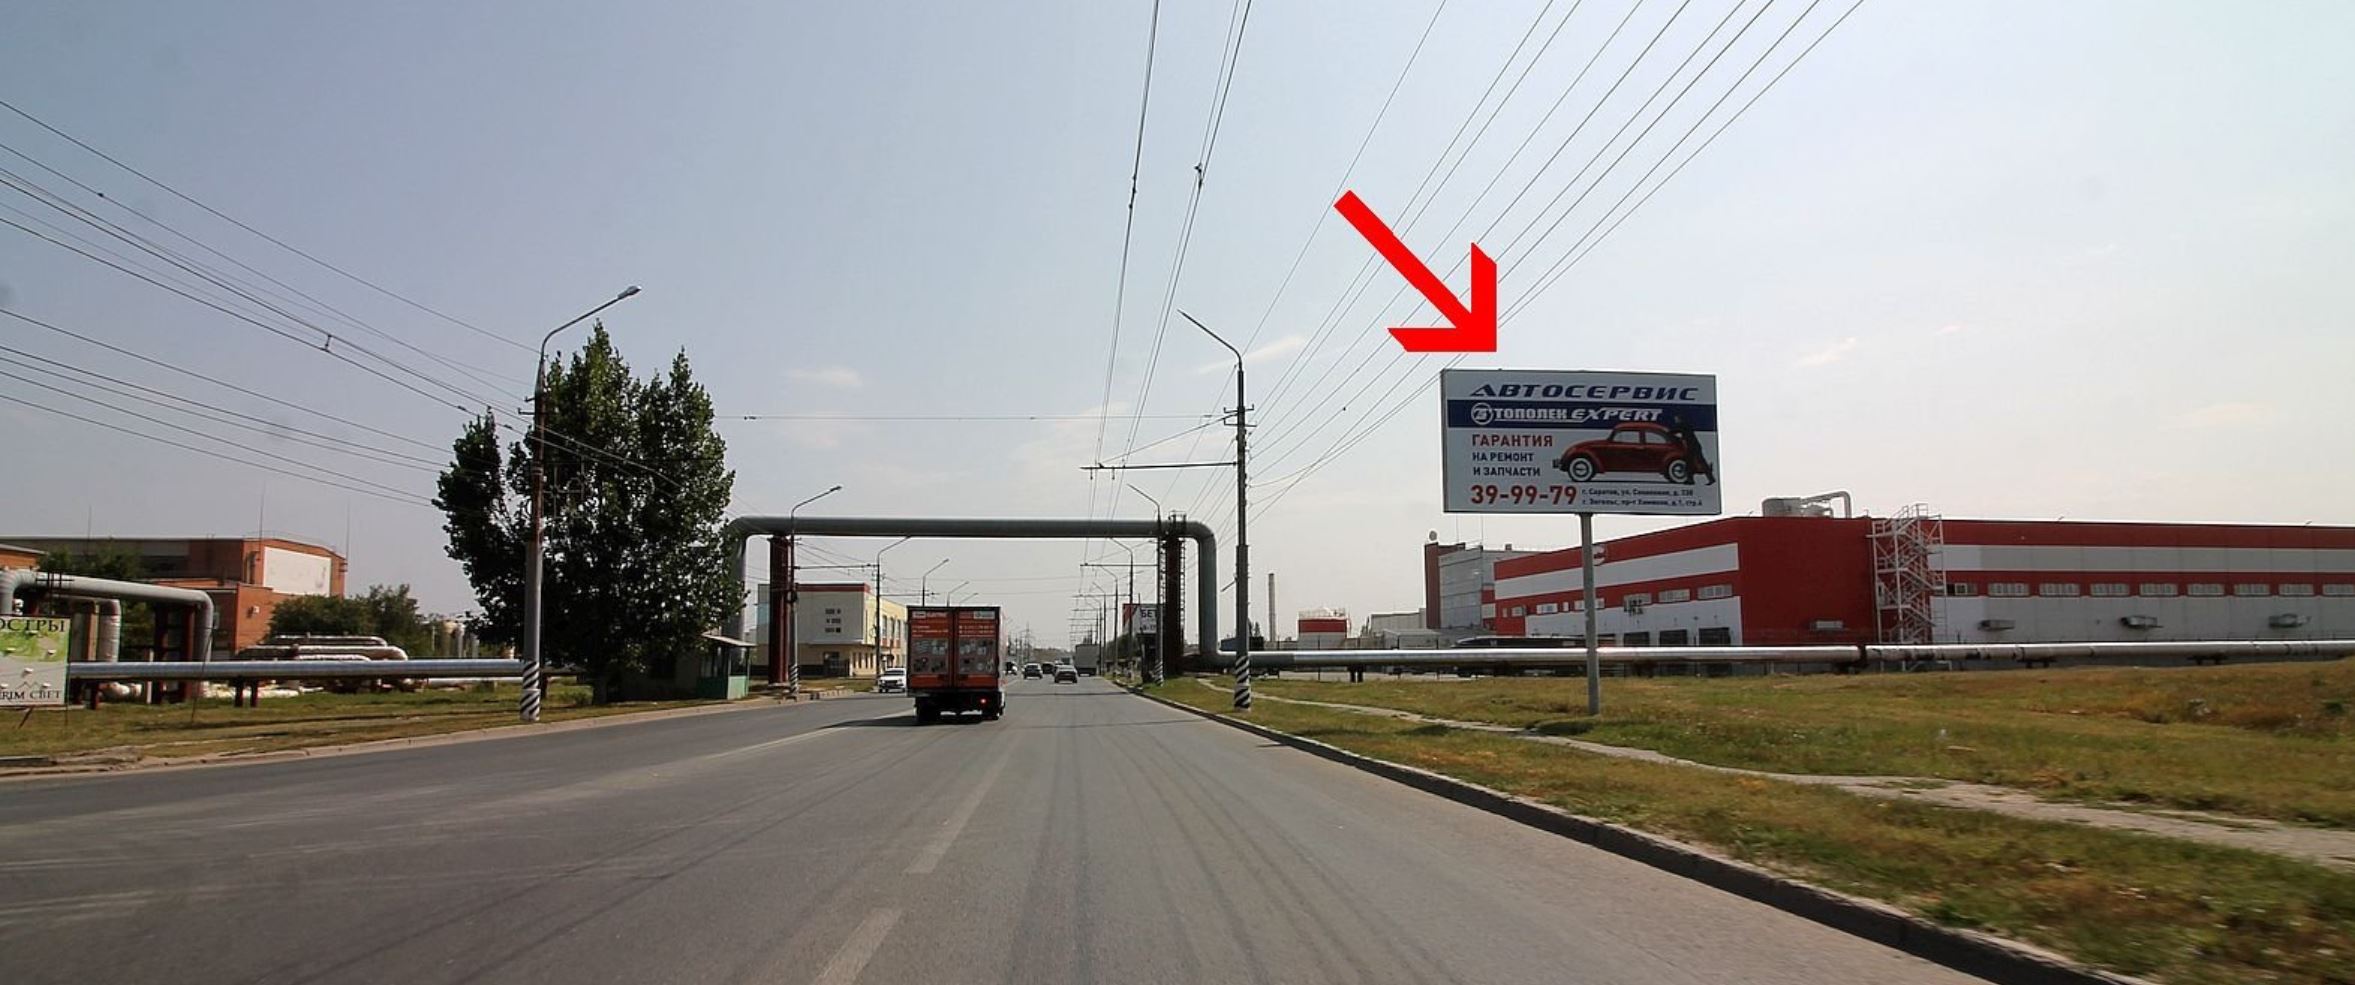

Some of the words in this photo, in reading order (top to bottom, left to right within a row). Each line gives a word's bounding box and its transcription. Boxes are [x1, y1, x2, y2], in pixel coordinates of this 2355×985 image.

[1470, 384, 1699, 400] АВТОСЕРВИС
[1494, 408, 1568, 421] ТОПОЛЕК
[1571, 407, 1663, 422] EXPERT
[1472, 434, 1553, 447] ГАРАНТИЯ
[1472, 452, 1489, 462] НА
[1490, 452, 1534, 462] РЕМОНТ
[1473, 467, 1481, 476] И
[1483, 467, 1541, 477] ЗАПЧАСТИ
[1471, 484, 1577, 505] 39-99-79
